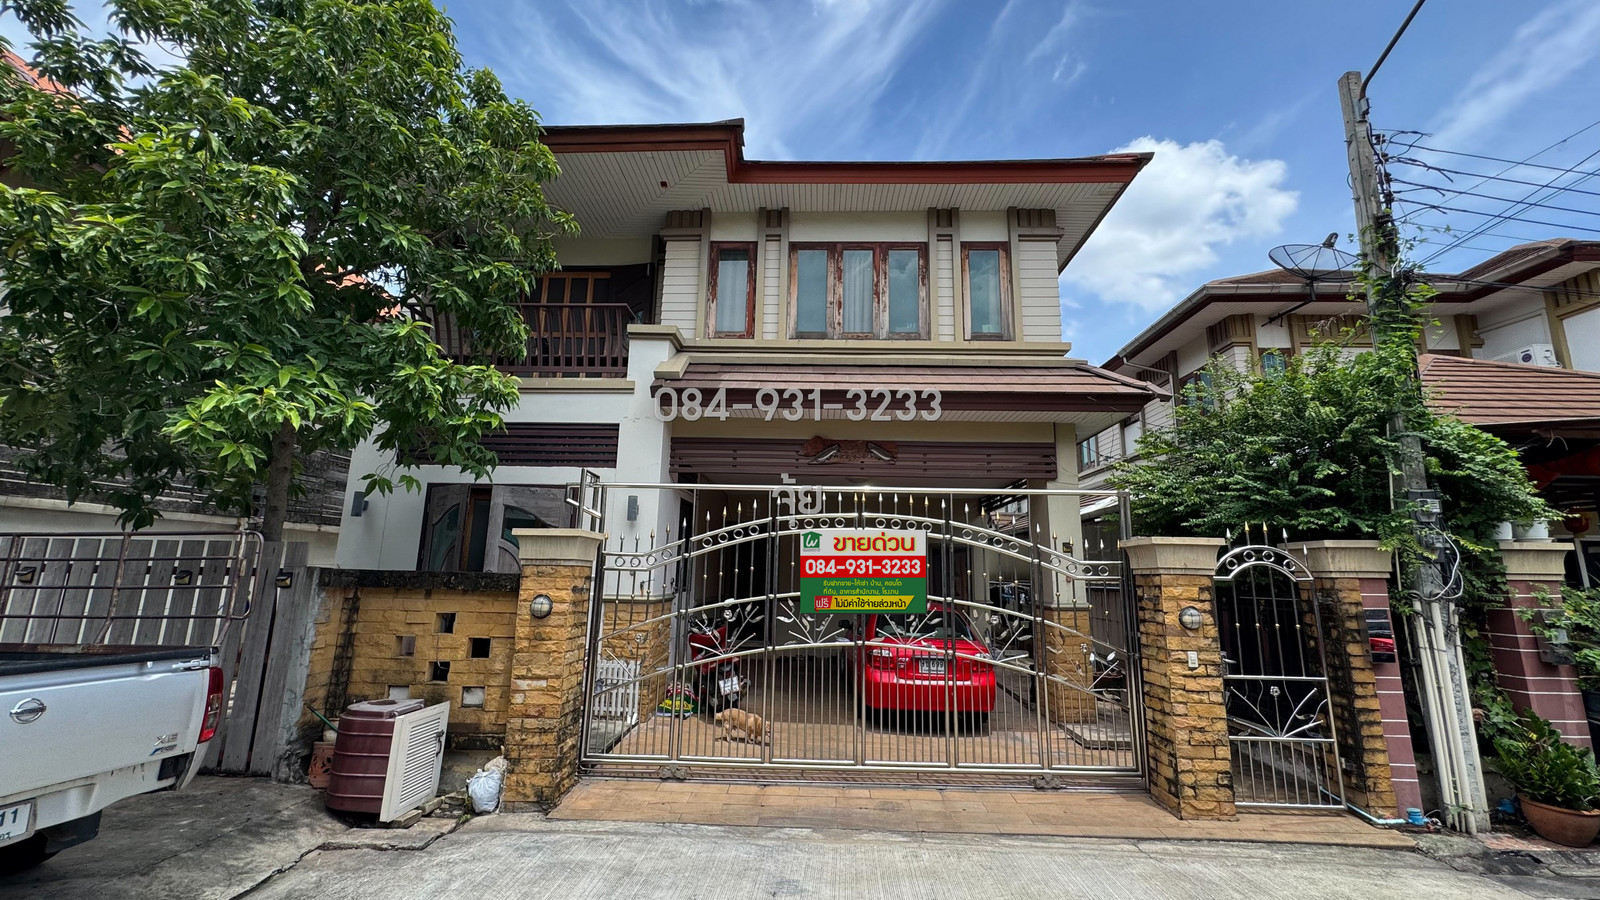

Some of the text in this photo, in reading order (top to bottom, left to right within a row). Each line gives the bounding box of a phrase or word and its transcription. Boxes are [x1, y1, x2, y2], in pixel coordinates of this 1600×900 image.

[833, 531, 915, 552] ขายด่วน
[805, 559, 921, 575] 084-931-3233
[884, 579, 902, 587] คอนโด
[882, 587, 899, 595] โรงงาน
[815, 597, 829, 608] ฟรี
[834, 597, 906, 608] ไม่มีค่าใช้จ่ายล่วงหน้า
